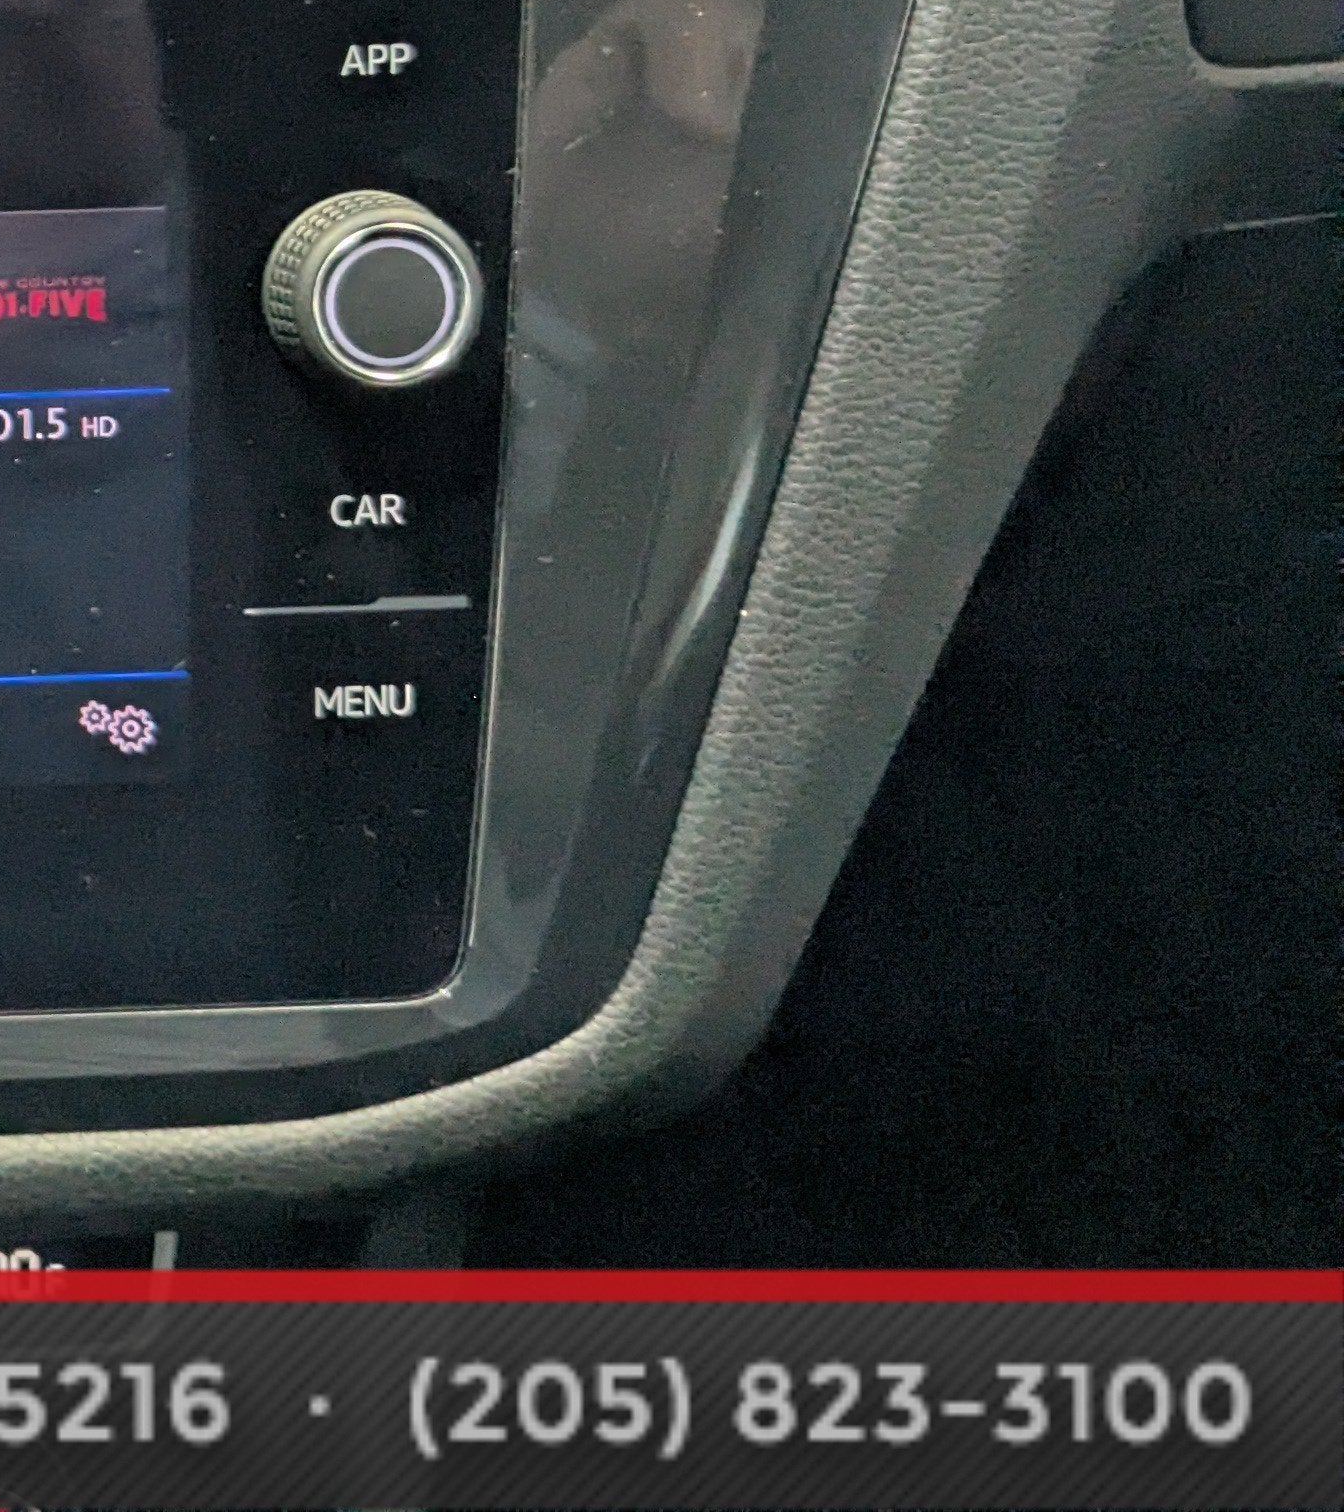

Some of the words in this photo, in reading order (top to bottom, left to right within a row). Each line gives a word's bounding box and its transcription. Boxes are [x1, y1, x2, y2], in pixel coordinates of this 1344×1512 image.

[340, 42, 416, 77] APP
[81, 414, 119, 439] HD
[330, 493, 406, 528] CAR
[314, 683, 417, 719] MENU
